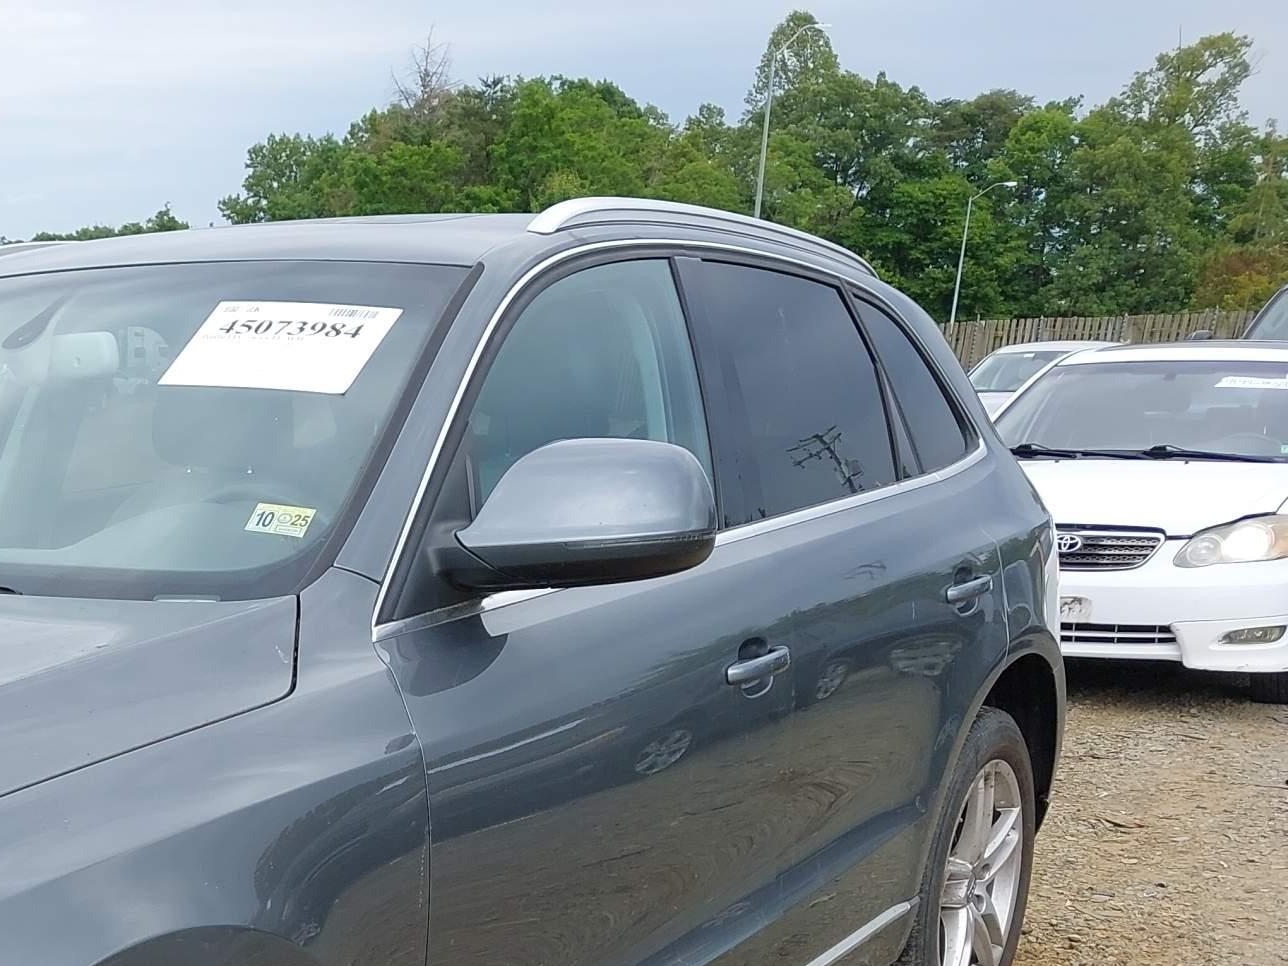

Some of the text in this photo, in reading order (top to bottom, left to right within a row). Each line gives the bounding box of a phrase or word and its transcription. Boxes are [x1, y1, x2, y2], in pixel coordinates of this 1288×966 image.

[219, 319, 364, 339] 45073984
[255, 511, 311, 528] 10 25
